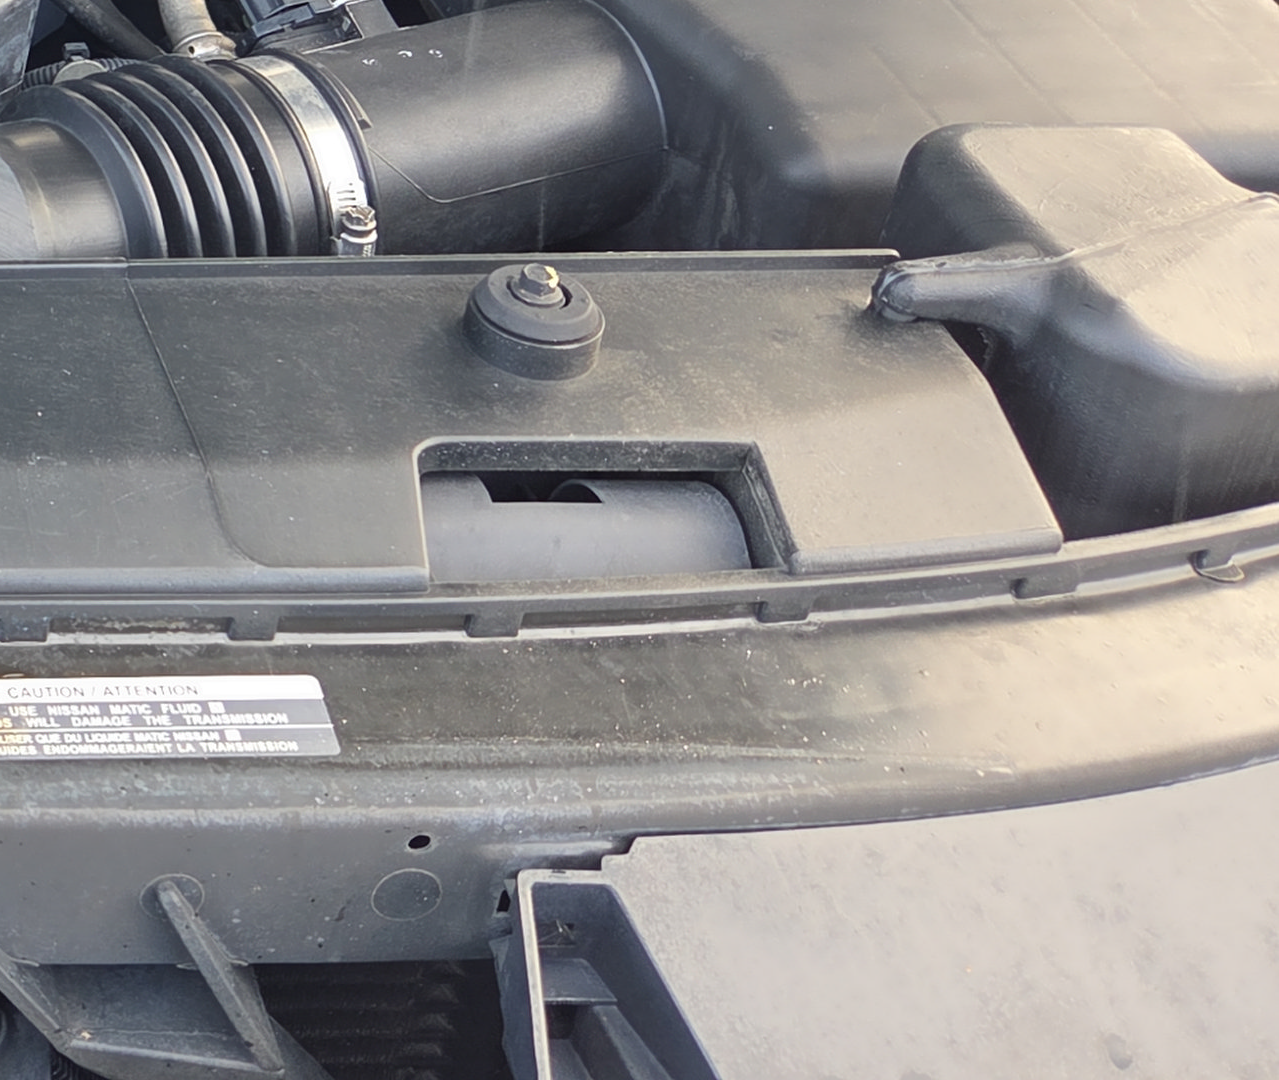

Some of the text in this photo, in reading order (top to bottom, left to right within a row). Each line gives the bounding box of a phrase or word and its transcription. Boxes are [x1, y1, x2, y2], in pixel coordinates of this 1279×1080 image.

[7, 686, 85, 699] CAUTION
[103, 685, 199, 697] ATTENTION
[7, 706, 38, 717] USE
[47, 705, 100, 717] NISSAN
[109, 704, 152, 715] MATIC
[161, 703, 202, 714] FLUID
[25, 717, 61, 728] WILL
[71, 716, 132, 727] DAMAGE
[143, 715, 173, 726] THE
[184, 713, 289, 725] TRANSMISSION
[35, 733, 62, 744] QUE
[65, 732, 82, 743] DU
[84, 732, 132, 743] LIQUIDE
[134, 731, 170, 742] MATIC
[173, 731, 220, 742] NISSAN
[43, 742, 173, 755] ENDOMMAGERAIENT
[177, 741, 196, 752] LA
[200, 741, 299, 753] TRANSMISSION
